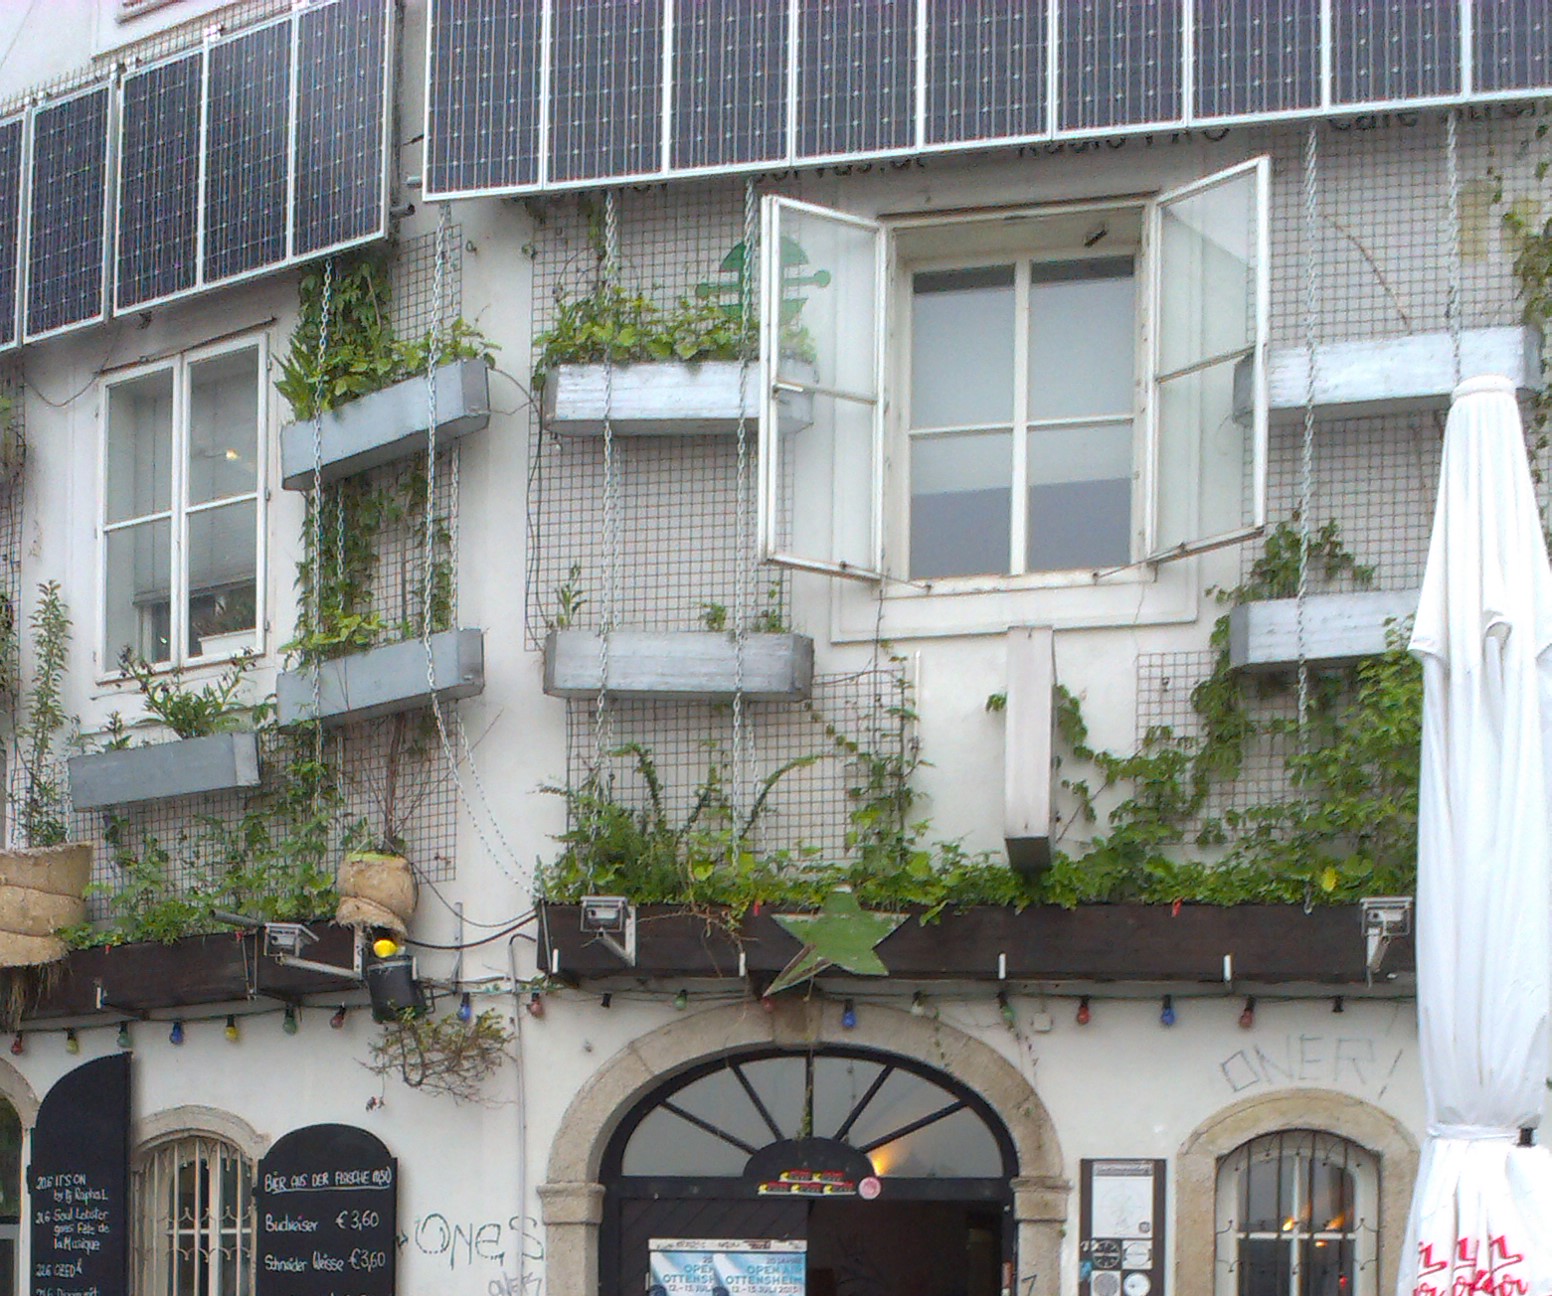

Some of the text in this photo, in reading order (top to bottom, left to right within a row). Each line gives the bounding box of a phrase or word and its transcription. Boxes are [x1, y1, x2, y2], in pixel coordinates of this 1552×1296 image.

[312, 1172, 329, 1187] DER
[53, 1207, 73, 1222] Soul
[265, 1213, 318, 1232] Budweiser
[312, 1251, 344, 1272] Weisse
[747, 1265, 782, 1274] OPEN
[725, 1275, 802, 1286] OTTENSHEIM
